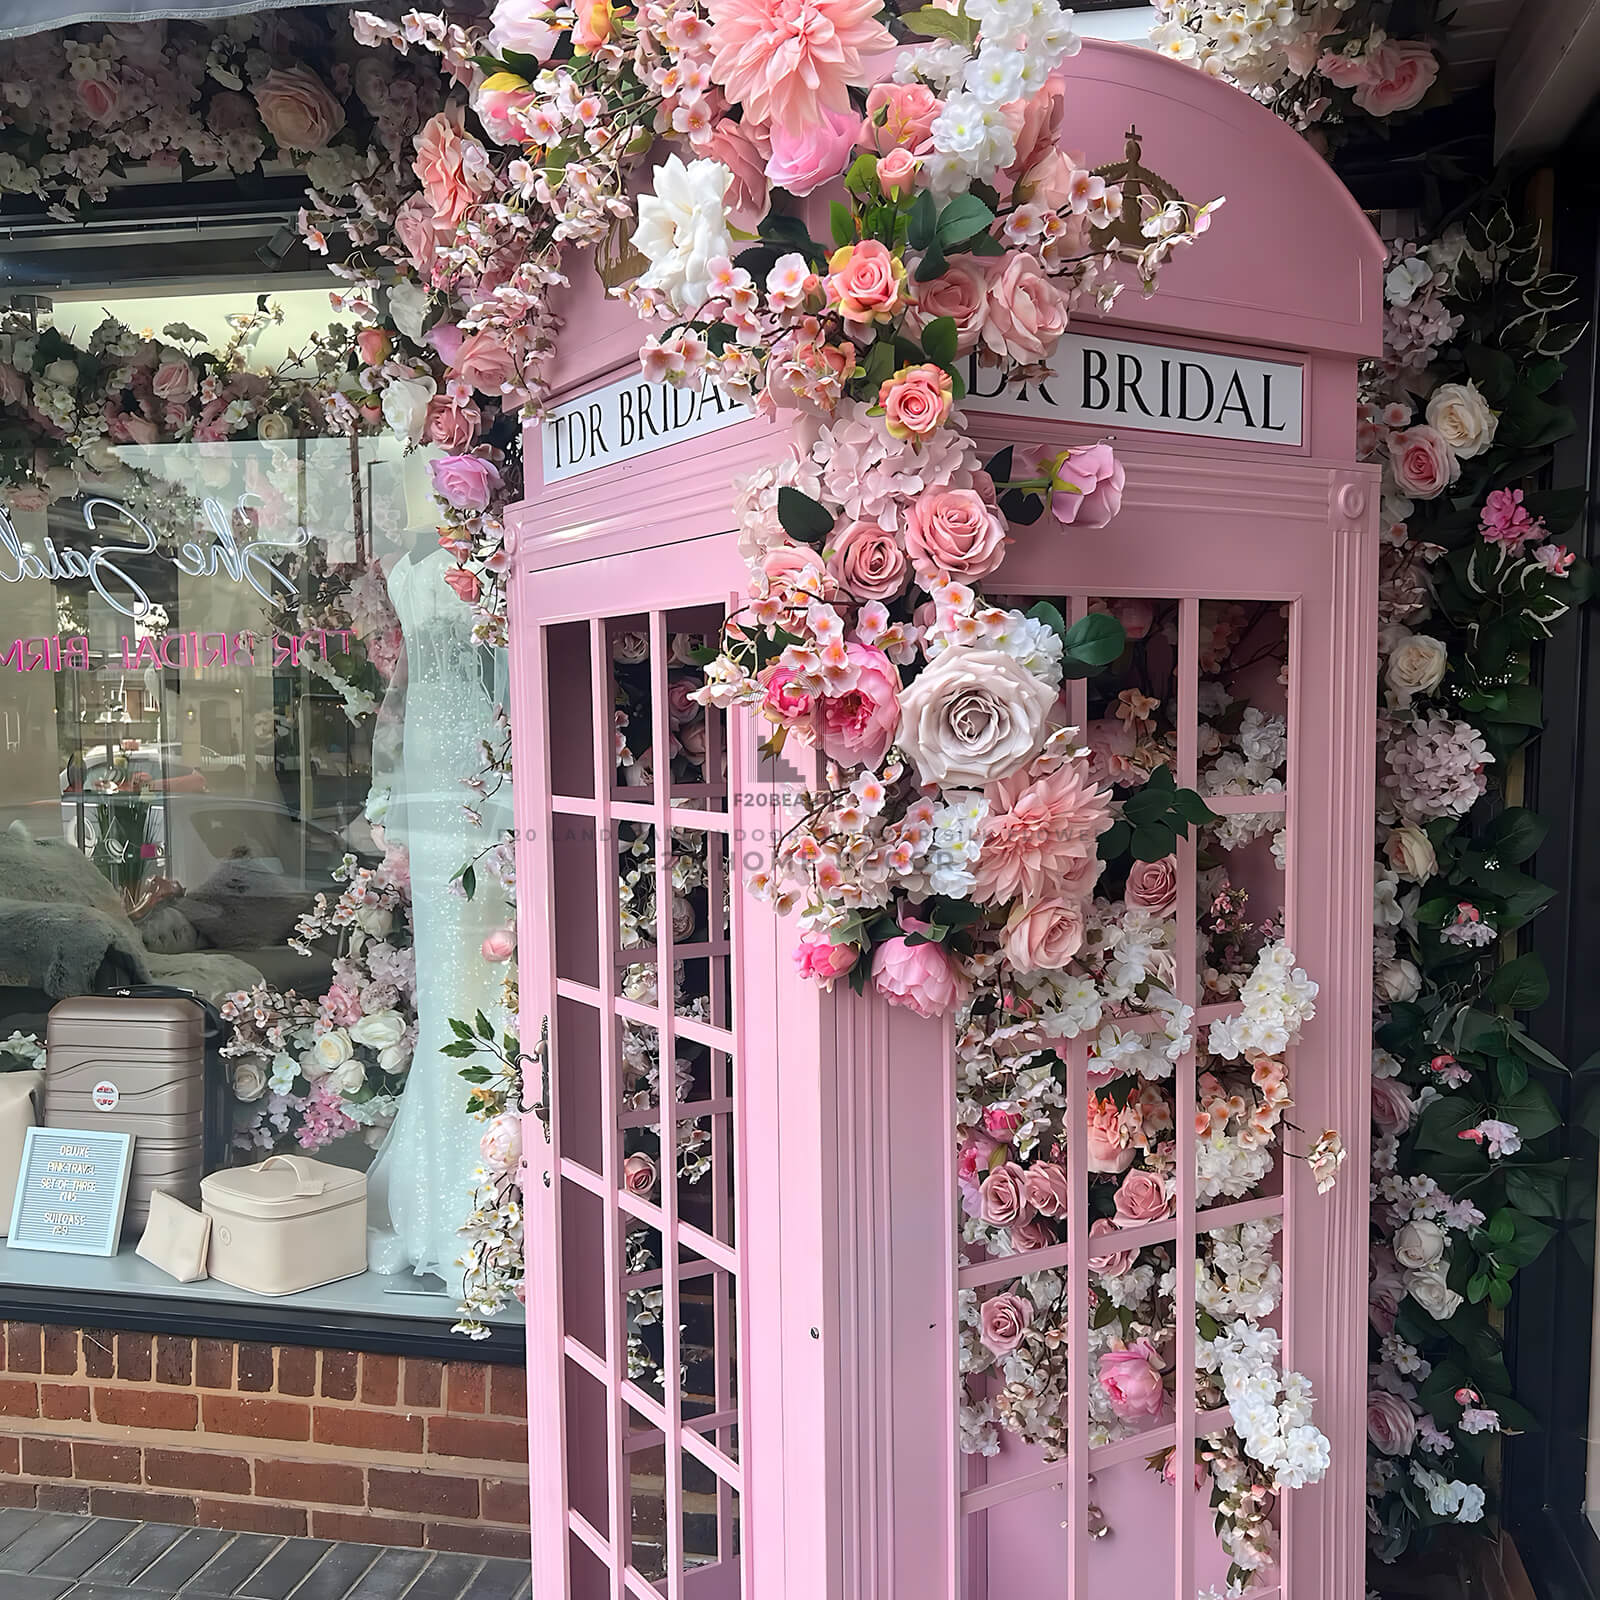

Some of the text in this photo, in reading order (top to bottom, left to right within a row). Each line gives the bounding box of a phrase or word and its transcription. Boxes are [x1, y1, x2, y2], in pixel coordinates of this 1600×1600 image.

[550, 371, 745, 469] TDR BRIDA
[1080, 348, 1287, 432] BRIDAL
